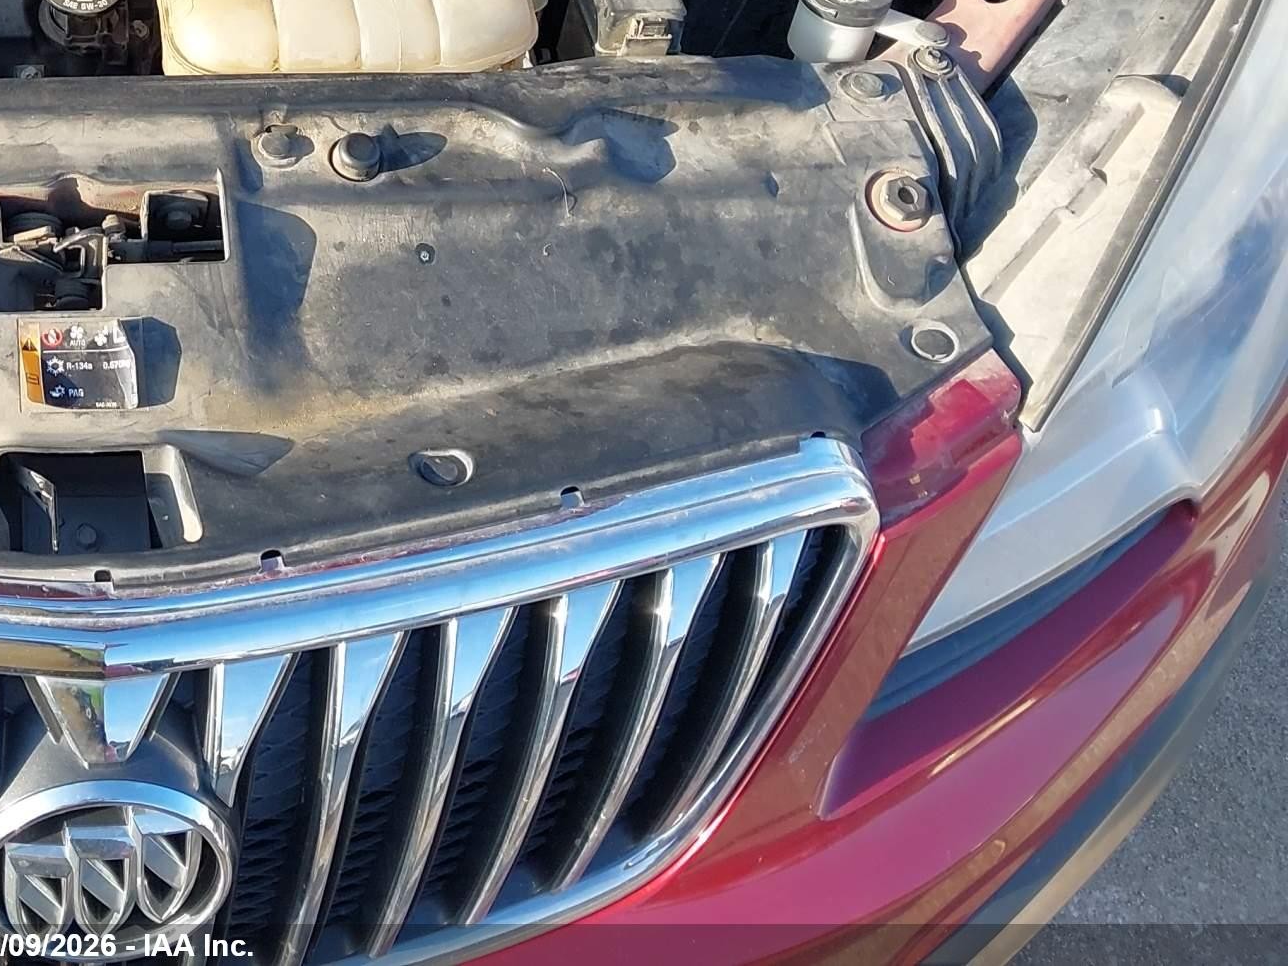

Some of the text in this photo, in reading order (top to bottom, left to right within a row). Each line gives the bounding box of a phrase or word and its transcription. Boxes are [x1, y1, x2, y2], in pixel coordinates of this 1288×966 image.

[62, 0, 108, 10] SAE 5W-30
[69, 339, 86, 347] AUTO
[66, 361, 93, 371] R-134a
[68, 388, 85, 398] PAG
